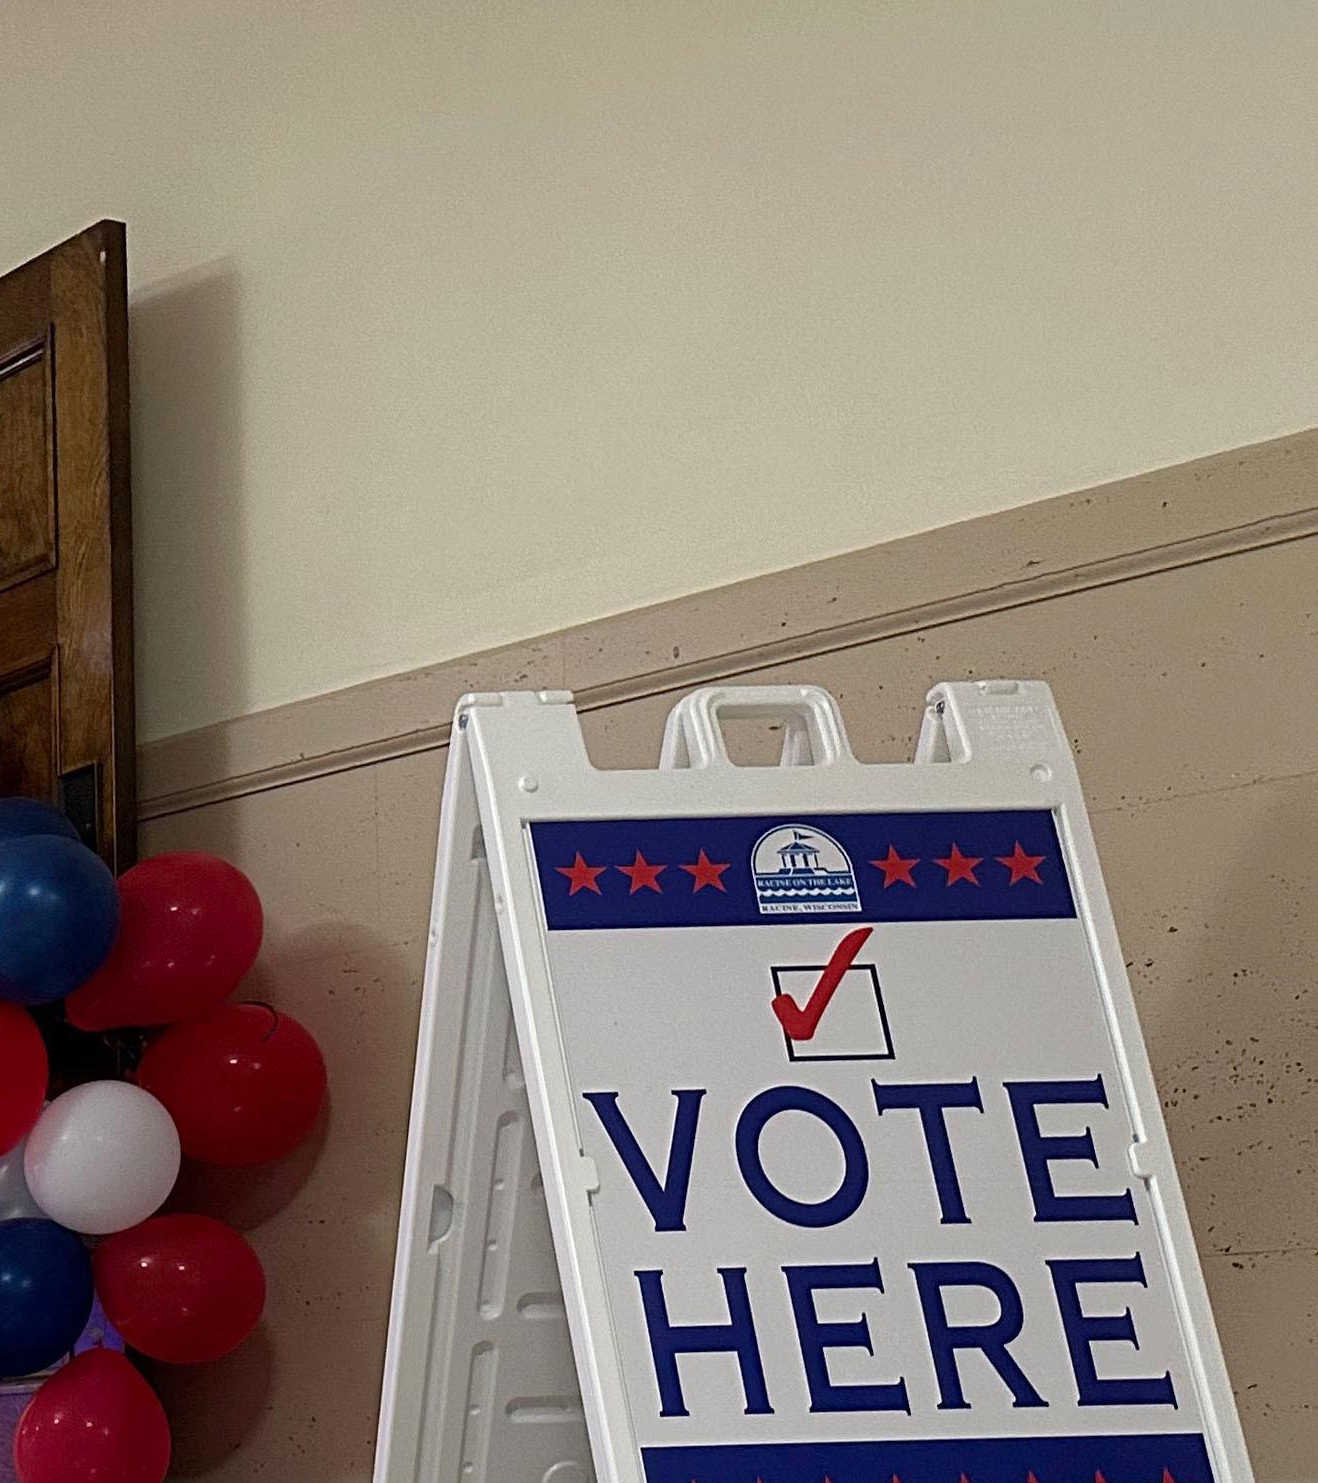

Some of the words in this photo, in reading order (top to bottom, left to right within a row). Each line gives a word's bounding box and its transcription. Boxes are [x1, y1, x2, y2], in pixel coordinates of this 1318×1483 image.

[757, 878, 792, 887] RACINE
[792, 878, 807, 887] ON
[807, 878, 826, 887] THE
[827, 877, 852, 886] LAKE
[803, 903, 859, 911] WISCONSIN
[582, 1073, 1140, 1233] VOTE
[634, 1250, 1179, 1418] HERE
